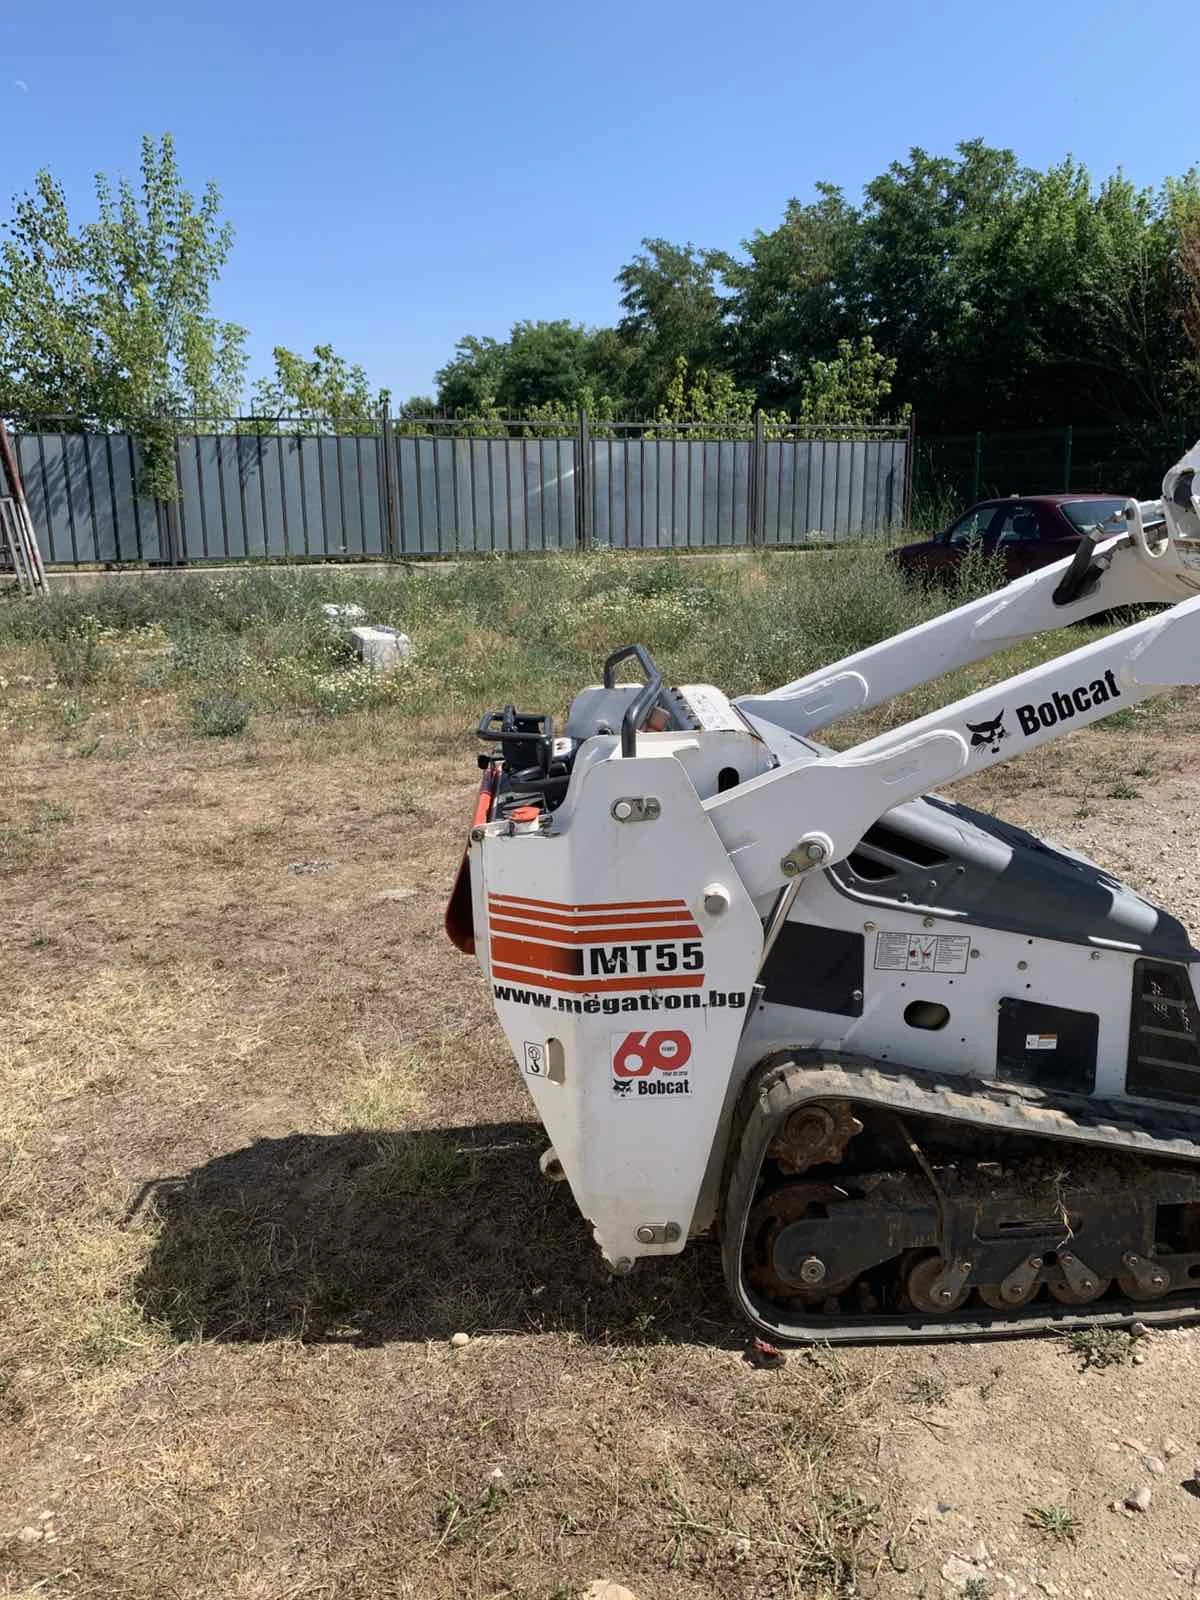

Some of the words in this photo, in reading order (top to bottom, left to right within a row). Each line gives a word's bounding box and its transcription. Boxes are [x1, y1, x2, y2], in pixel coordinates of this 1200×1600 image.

[1015, 669, 1121, 737] Bobcat
[590, 942, 704, 976] MT55
[493, 984, 746, 1015] www.megatron.bg
[613, 1030, 692, 1077] 60
[638, 1079, 689, 1095] Bobcat
